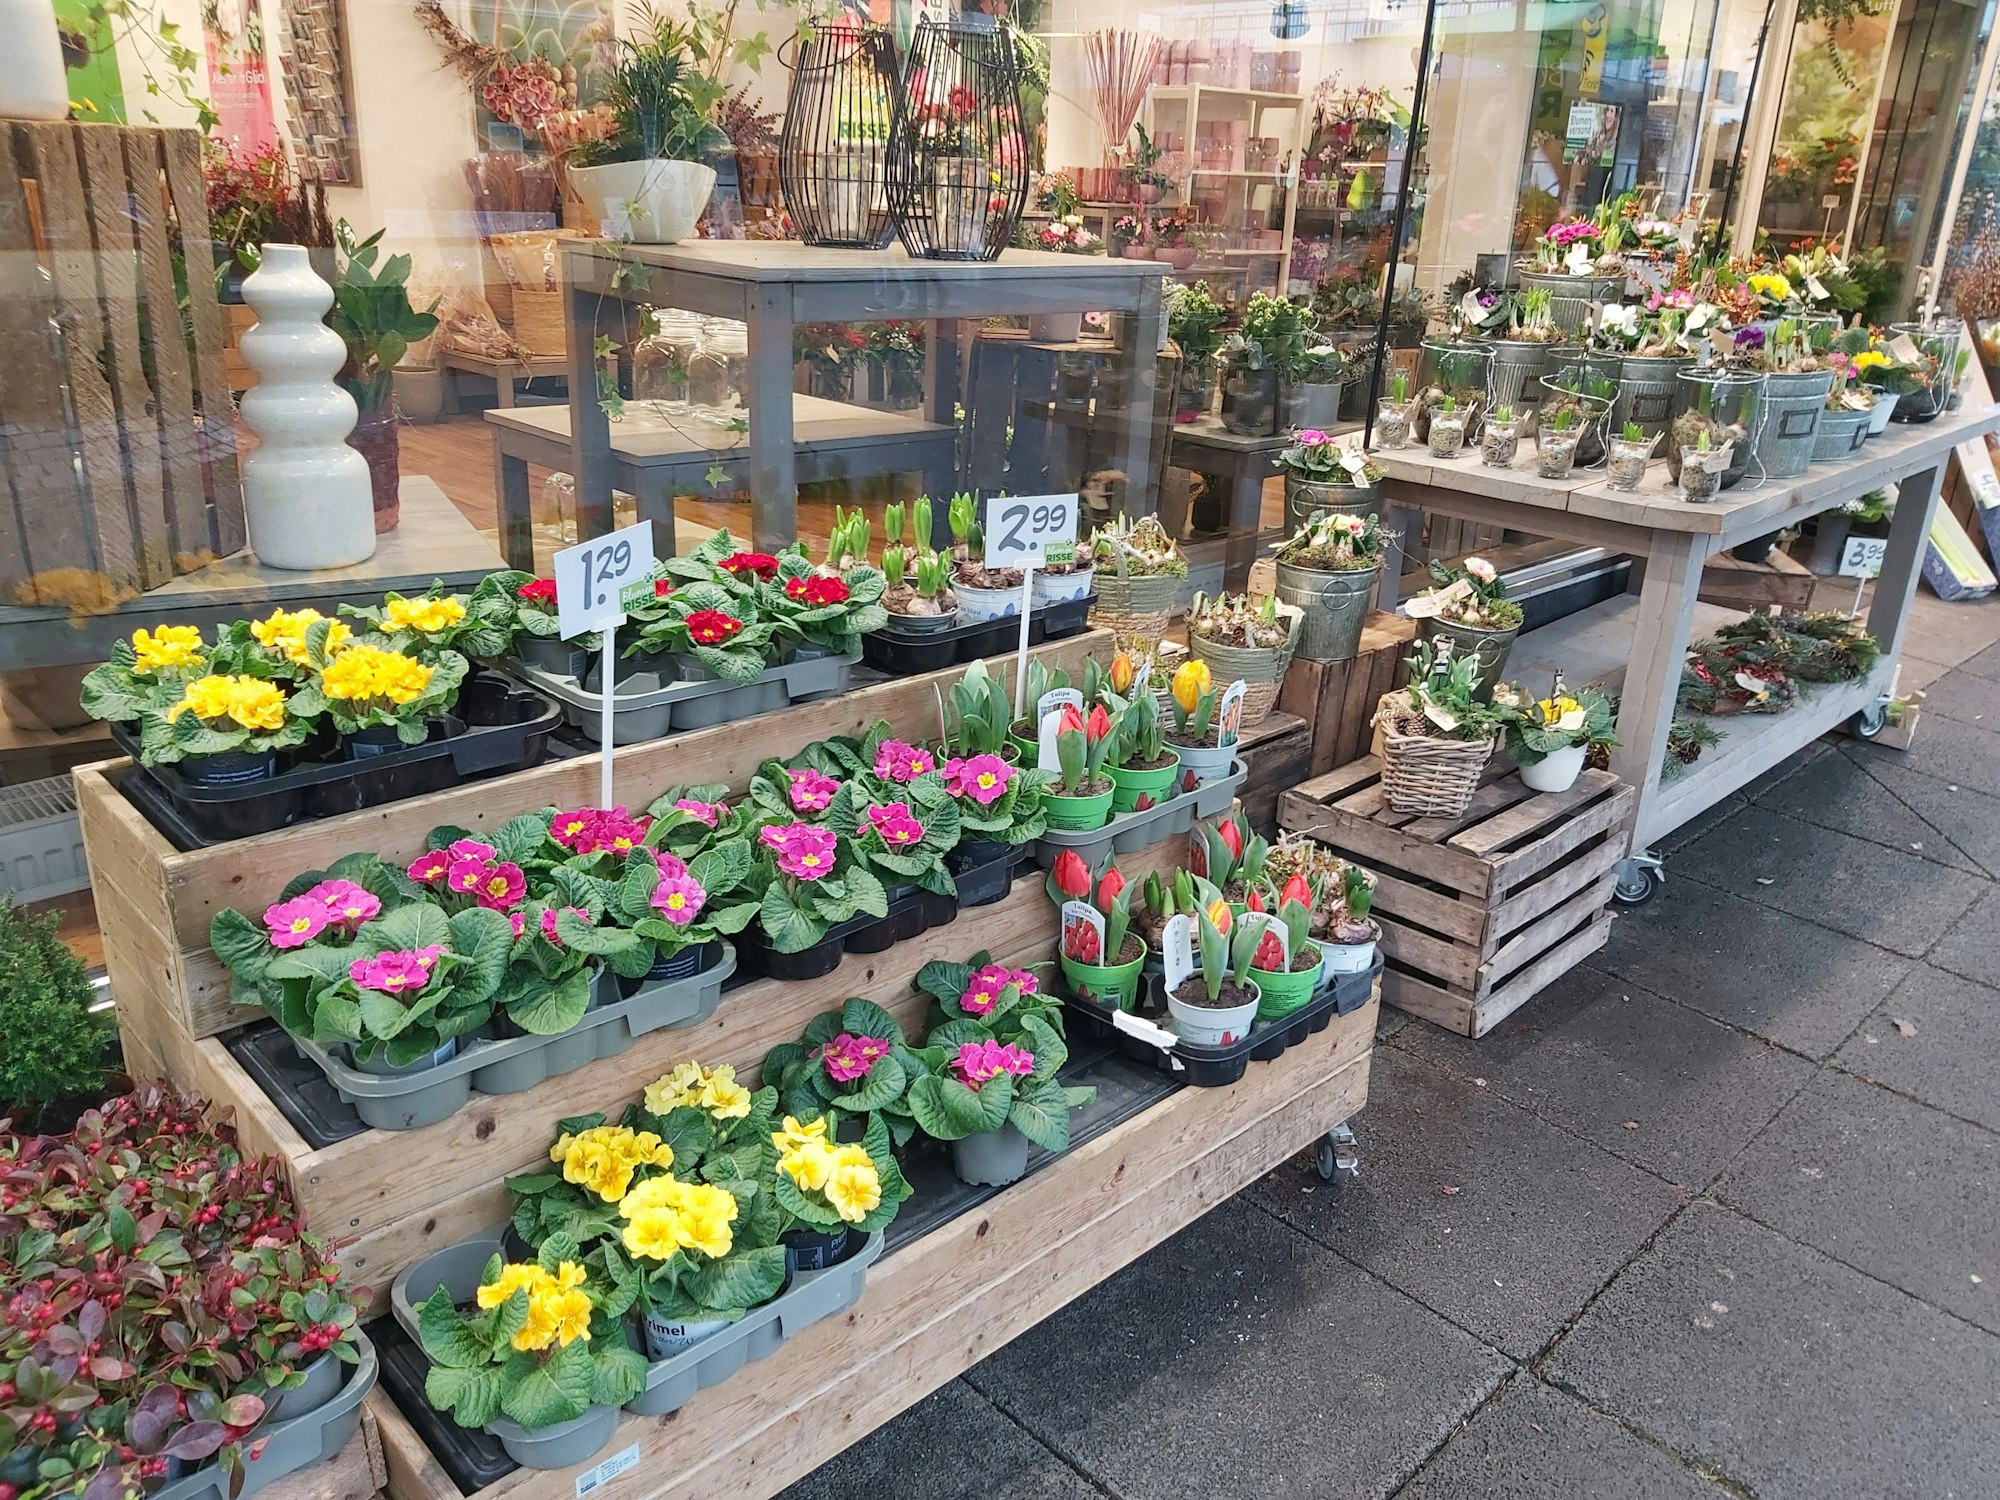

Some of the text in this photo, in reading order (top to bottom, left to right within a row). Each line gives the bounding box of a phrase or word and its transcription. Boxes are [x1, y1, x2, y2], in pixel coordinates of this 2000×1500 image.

[998, 504, 1066, 552] 2.99
[1046, 553, 1073, 562] RISSE
[581, 540, 631, 611] 1.29
[623, 592, 656, 613] RISSE
[648, 1319, 685, 1336] rimel
